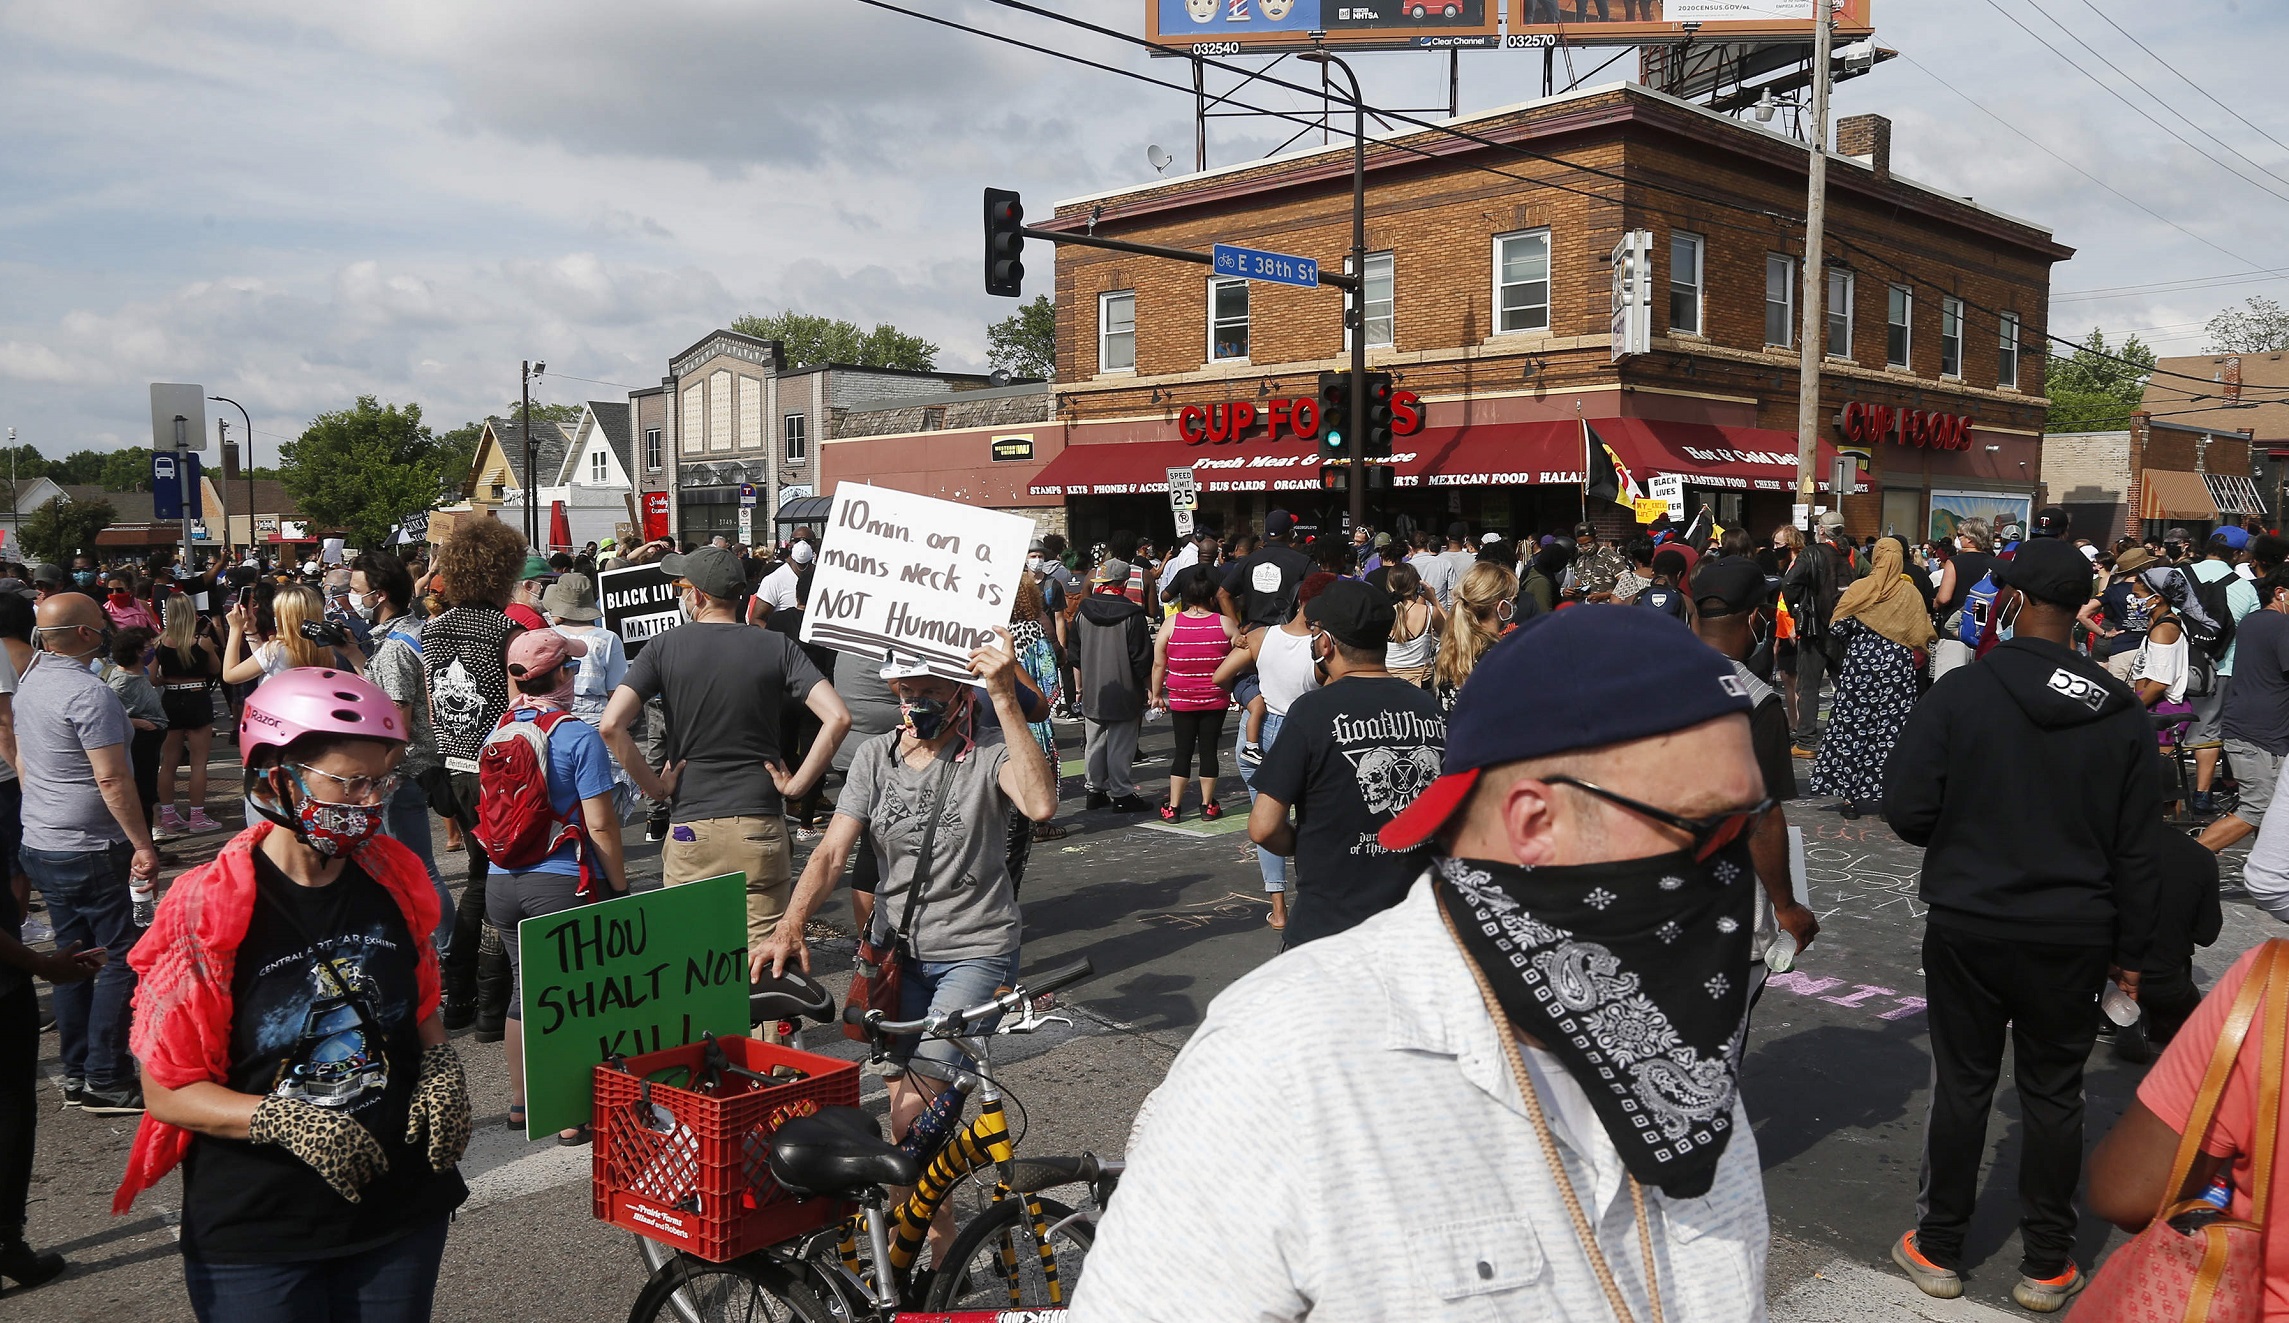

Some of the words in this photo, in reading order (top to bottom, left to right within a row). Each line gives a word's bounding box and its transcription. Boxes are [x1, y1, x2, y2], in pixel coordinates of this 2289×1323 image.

[1192, 42, 1240, 55] 032540
[1432, 38, 1453, 46] Clear
[1453, 37, 1485, 45] Channel
[1507, 35, 1556, 47] 032570
[1238, 254, 1248, 271] E
[1255, 256, 1292, 278] 38th
[1298, 263, 1315, 282] St
[1178, 401, 1255, 445] CUP
[1267, 390, 1420, 440] FOS
[1842, 401, 1896, 443] CUP
[1896, 407, 1974, 452] FOODS
[1191, 456, 1246, 470] Fresh
[1246, 456, 1300, 468] Meat
[1300, 454, 1320, 466] &
[1682, 445, 1717, 461] Hot
[1716, 448, 1736, 463] &
[1735, 450, 1775, 465] Cold
[1030, 485, 1062, 495] STAMPS
[1066, 485, 1088, 495] KEYS
[1093, 484, 1128, 494] PHONES
[1209, 482, 1230, 491] BUS
[1231, 481, 1266, 491] CARDS
[1428, 473, 1489, 485] MEXICAN
[1490, 472, 1529, 484] FOOD
[1170, 472, 1192, 480] SPEED
[1653, 477, 1677, 487] BLACK
[1689, 473, 1727, 487] EASTERN
[1726, 477, 1747, 488] FOOD
[1754, 480, 1781, 490] CHEESE
[1172, 490, 1195, 505] 25
[1656, 487, 1676, 497] LIVES
[1667, 502, 1682, 511] TER
[719, 518, 733, 526] 3749
[926, 532, 961, 555] on
[975, 543, 992, 564] a
[824, 548, 890, 578] mans
[977, 572, 1004, 606] is
[606, 586, 650, 610] BLACK
[652, 582, 675, 602] LIV
[626, 616, 676, 639] MATTER
[814, 586, 874, 620] NOT
[884, 601, 996, 650] Humane
[250, 709, 283, 729] Razor
[544, 906, 647, 974] THOU
[258, 951, 304, 977] CENTRAL
[363, 935, 398, 951] EXHIBIT
[537, 962, 671, 1035] SHALT
[684, 946, 749, 996] NOT
[633, 1212, 656, 1226] Hiland
[655, 1221, 665, 1230] and
[664, 1223, 689, 1239] Roberts
[638, 1203, 662, 1219] Prairie
[661, 1211, 683, 1227] Farms
